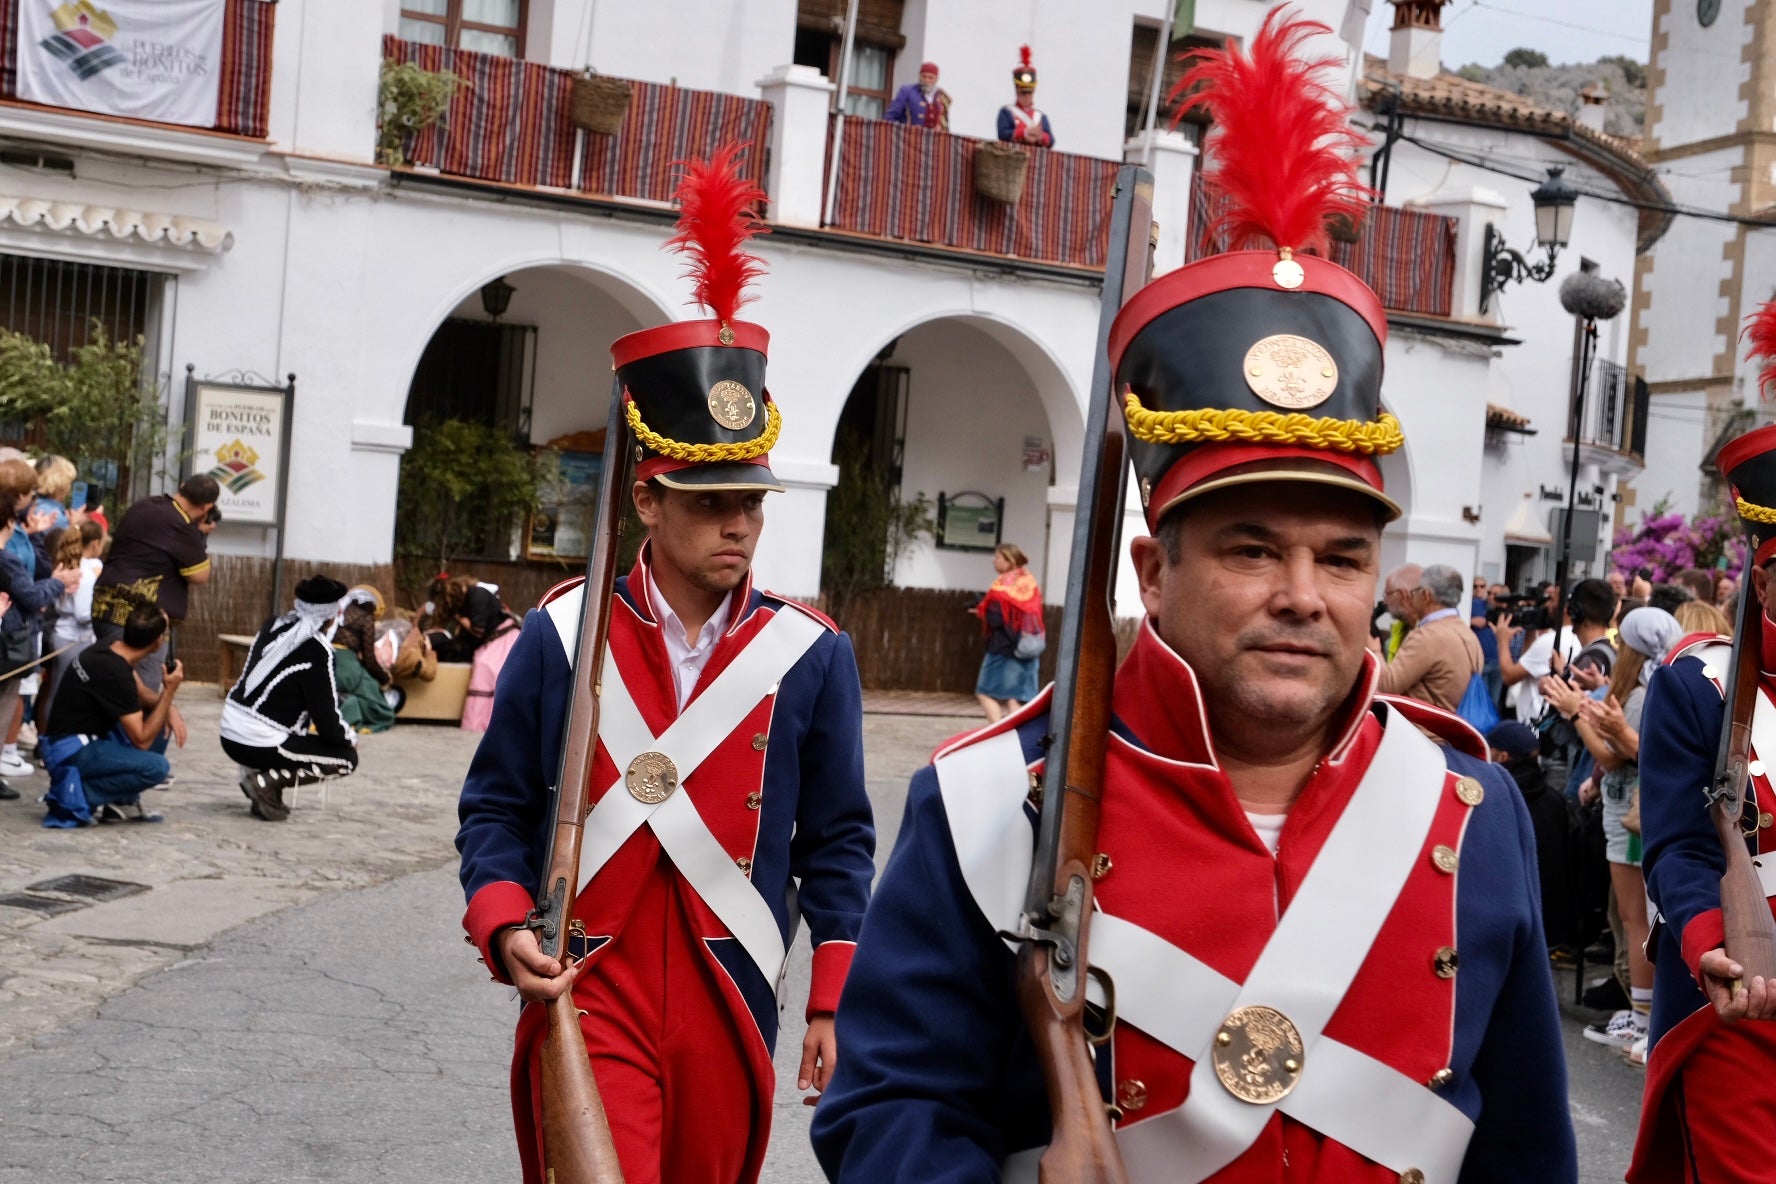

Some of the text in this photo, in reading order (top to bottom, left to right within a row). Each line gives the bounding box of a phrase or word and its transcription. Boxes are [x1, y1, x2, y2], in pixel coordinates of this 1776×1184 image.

[132, 52, 207, 75] BONITOS
[210, 409, 271, 424] BONITOS
[207, 422, 272, 437] DE ESPAÑA
[221, 497, 261, 508] AZALEMA
